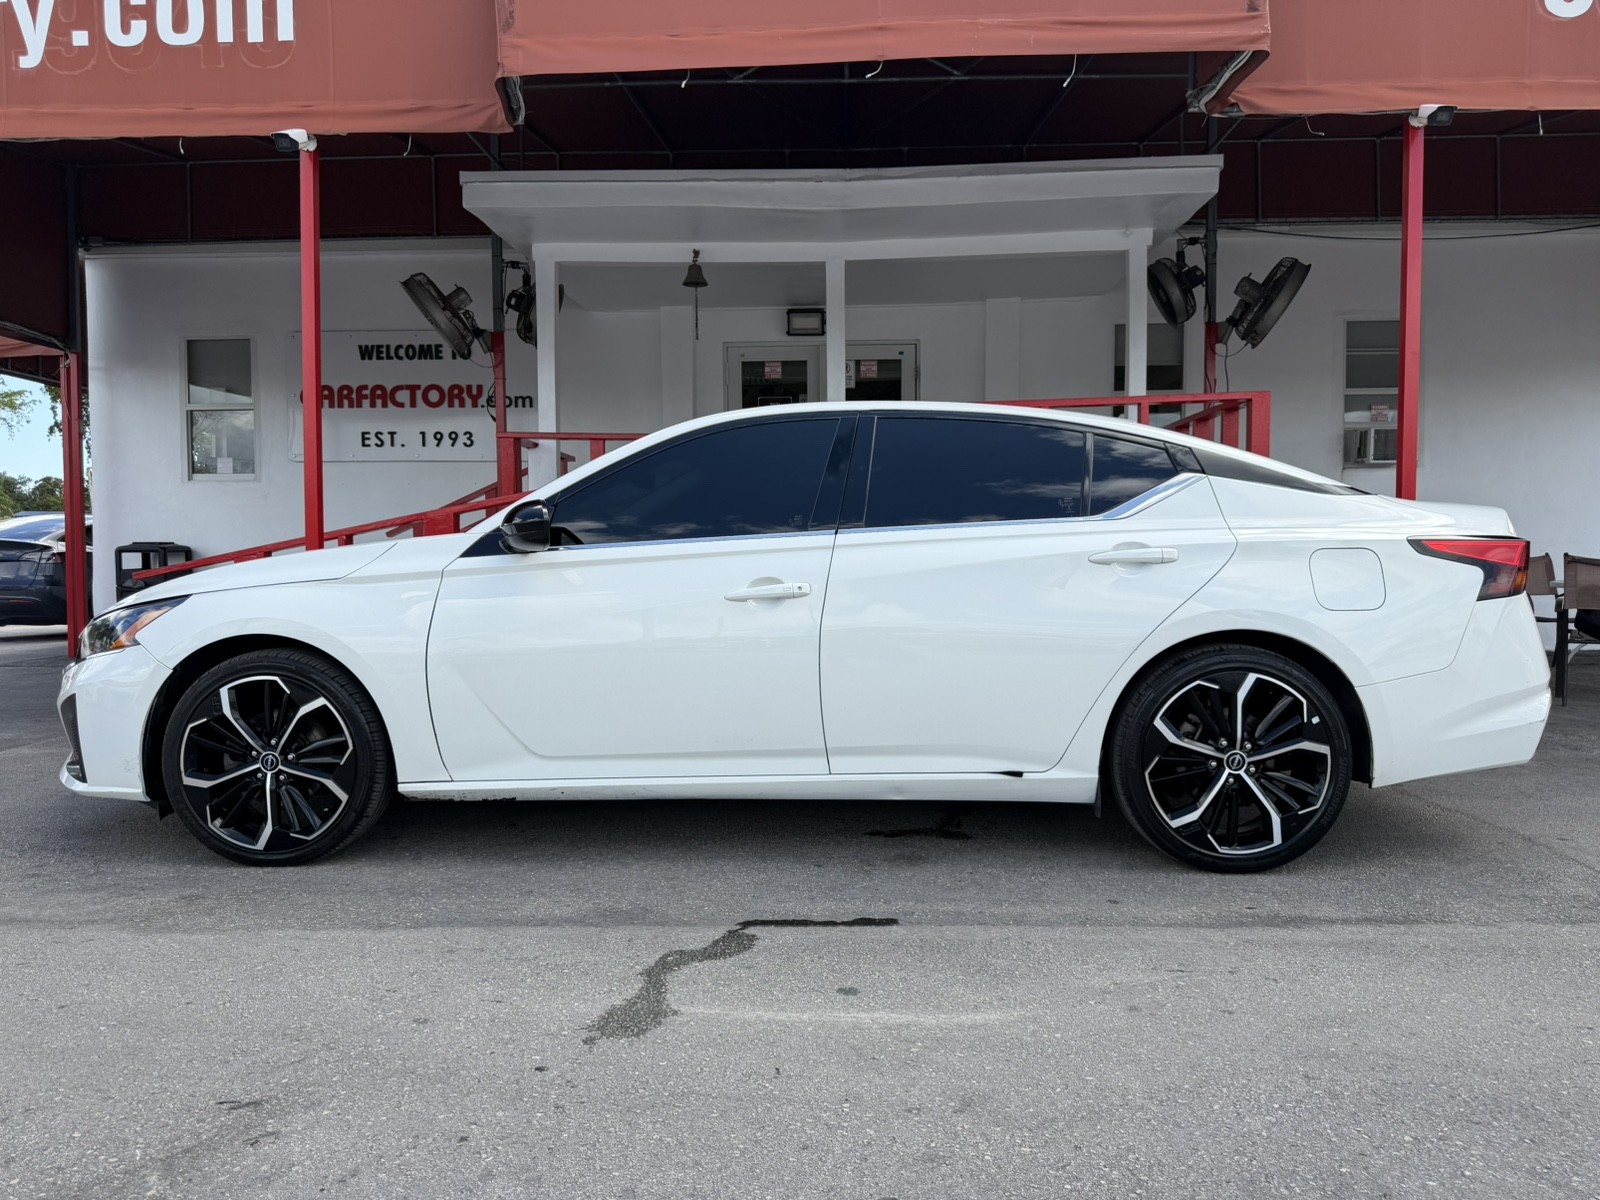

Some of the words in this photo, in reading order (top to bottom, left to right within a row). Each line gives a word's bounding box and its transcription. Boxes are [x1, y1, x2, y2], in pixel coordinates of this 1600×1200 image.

[358, 344, 443, 361] WELCOME
[300, 384, 533, 409] ARFACTORY.com
[361, 431, 405, 448] EST.
[419, 431, 475, 448] 1993
